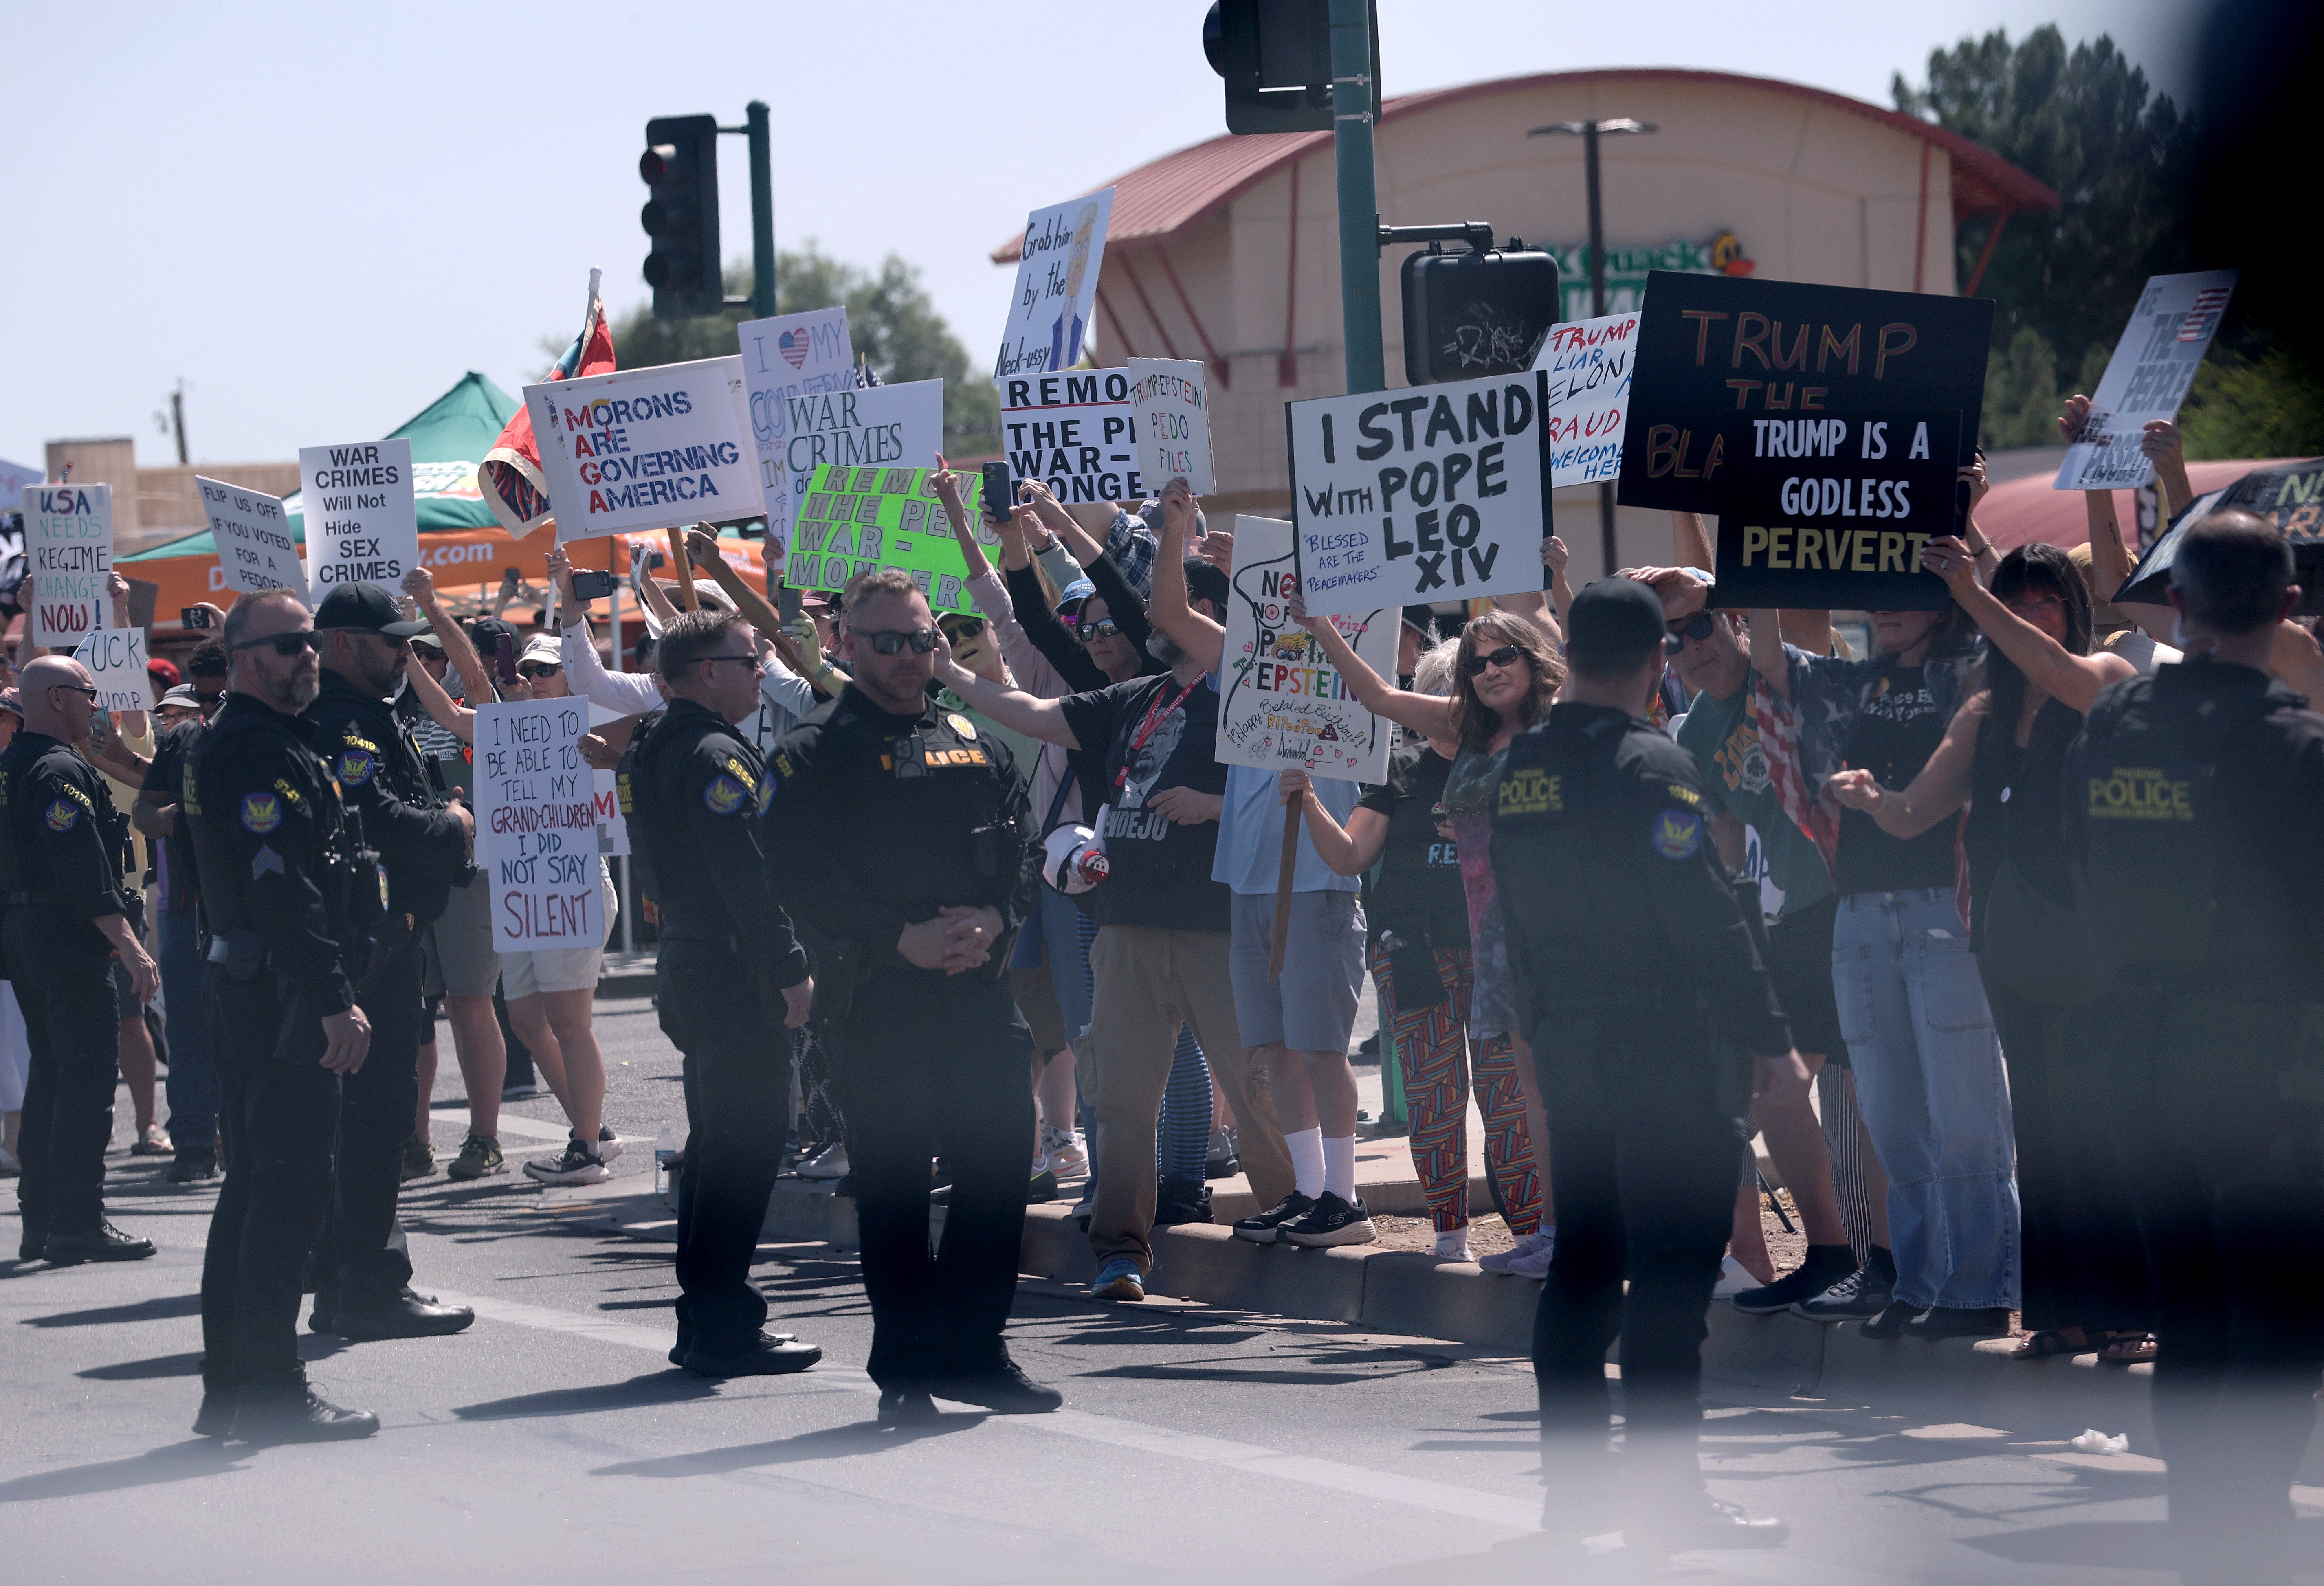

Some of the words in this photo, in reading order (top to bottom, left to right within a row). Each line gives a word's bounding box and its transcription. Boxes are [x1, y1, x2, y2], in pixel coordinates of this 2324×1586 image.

[1022, 218, 1051, 261] Grab
[1023, 273, 1039, 321] by
[1046, 261, 1065, 299] the
[753, 337, 769, 373] I
[811, 319, 842, 363] MY
[1553, 319, 1636, 353] TRUMP
[1682, 309, 1918, 380] TRUMP
[1553, 348, 1604, 373] LIAR
[1008, 373, 1130, 407] REMO
[1130, 373, 1202, 410] TRUMP-EPSTEIN
[1548, 350, 1625, 408] ELON
[564, 390, 692, 432] MORONS
[785, 391, 862, 434] WAR
[1152, 412, 1188, 441] PEDO
[1321, 413, 1335, 464] I
[1356, 383, 1534, 461] STAND
[1549, 409, 1620, 444] RAUD
[576, 428, 631, 458] ARE
[787, 423, 903, 473] CRIMES
[1007, 419, 1082, 450] THE
[1753, 419, 1847, 458] TRUMP
[1861, 421, 1888, 460] IS
[1909, 422, 1930, 460] A
[330, 446, 378, 467] WAR
[580, 441, 739, 485] GOVERNING
[1159, 450, 1193, 473] FILES
[315, 466, 399, 489] CRIMES
[589, 473, 719, 514] AMERICA
[824, 466, 983, 499] REMOV
[1011, 471, 1160, 507] MONGE
[1304, 481, 1374, 518] WITH
[1379, 441, 1508, 512] POPE
[41, 489, 91, 516] USA
[204, 485, 226, 503] FLIP
[234, 495, 251, 512] US
[257, 502, 278, 520] OFF
[323, 495, 351, 511] Will
[357, 493, 386, 510] Not
[803, 492, 883, 524] THE
[1781, 477, 1911, 519] GODLESS
[40, 516, 102, 539] NEEDS
[212, 516, 222, 531] IF
[224, 519, 250, 539] YOU
[252, 527, 291, 551] VOTED
[325, 521, 361, 536] Hide
[1383, 503, 1481, 561] LEO
[38, 546, 109, 573] REGIME
[236, 547, 261, 566] FOR
[268, 557, 277, 571] A
[340, 538, 381, 558] SEX
[1319, 553, 1339, 569] ARE
[1342, 551, 1365, 565] THE
[1742, 526, 1932, 573] PERVERT
[319, 560, 401, 583] CRIMES
[1414, 542, 1500, 593] XIV
[38, 576, 100, 600] CHANGE
[1331, 613, 1369, 632] Prize
[75, 631, 142, 672] FUCK
[1162, 695, 1183, 718] DIME
[1259, 699, 1314, 715] Belated
[493, 718, 501, 746] I
[510, 715, 551, 745] NEED
[558, 710, 578, 738] TO
[486, 751, 507, 778] BE
[515, 747, 551, 774] ABLE
[558, 745, 578, 770] TO
[501, 779, 537, 802] TELL
[552, 773, 578, 800] MY
[1499, 775, 1562, 805] POLICE
[2089, 777, 2191, 810] POLICE
[518, 835, 527, 856] I
[538, 833, 562, 854] DID
[501, 855, 538, 885] NOT
[548, 853, 588, 885] STAY
[503, 889, 593, 938] SILENT
